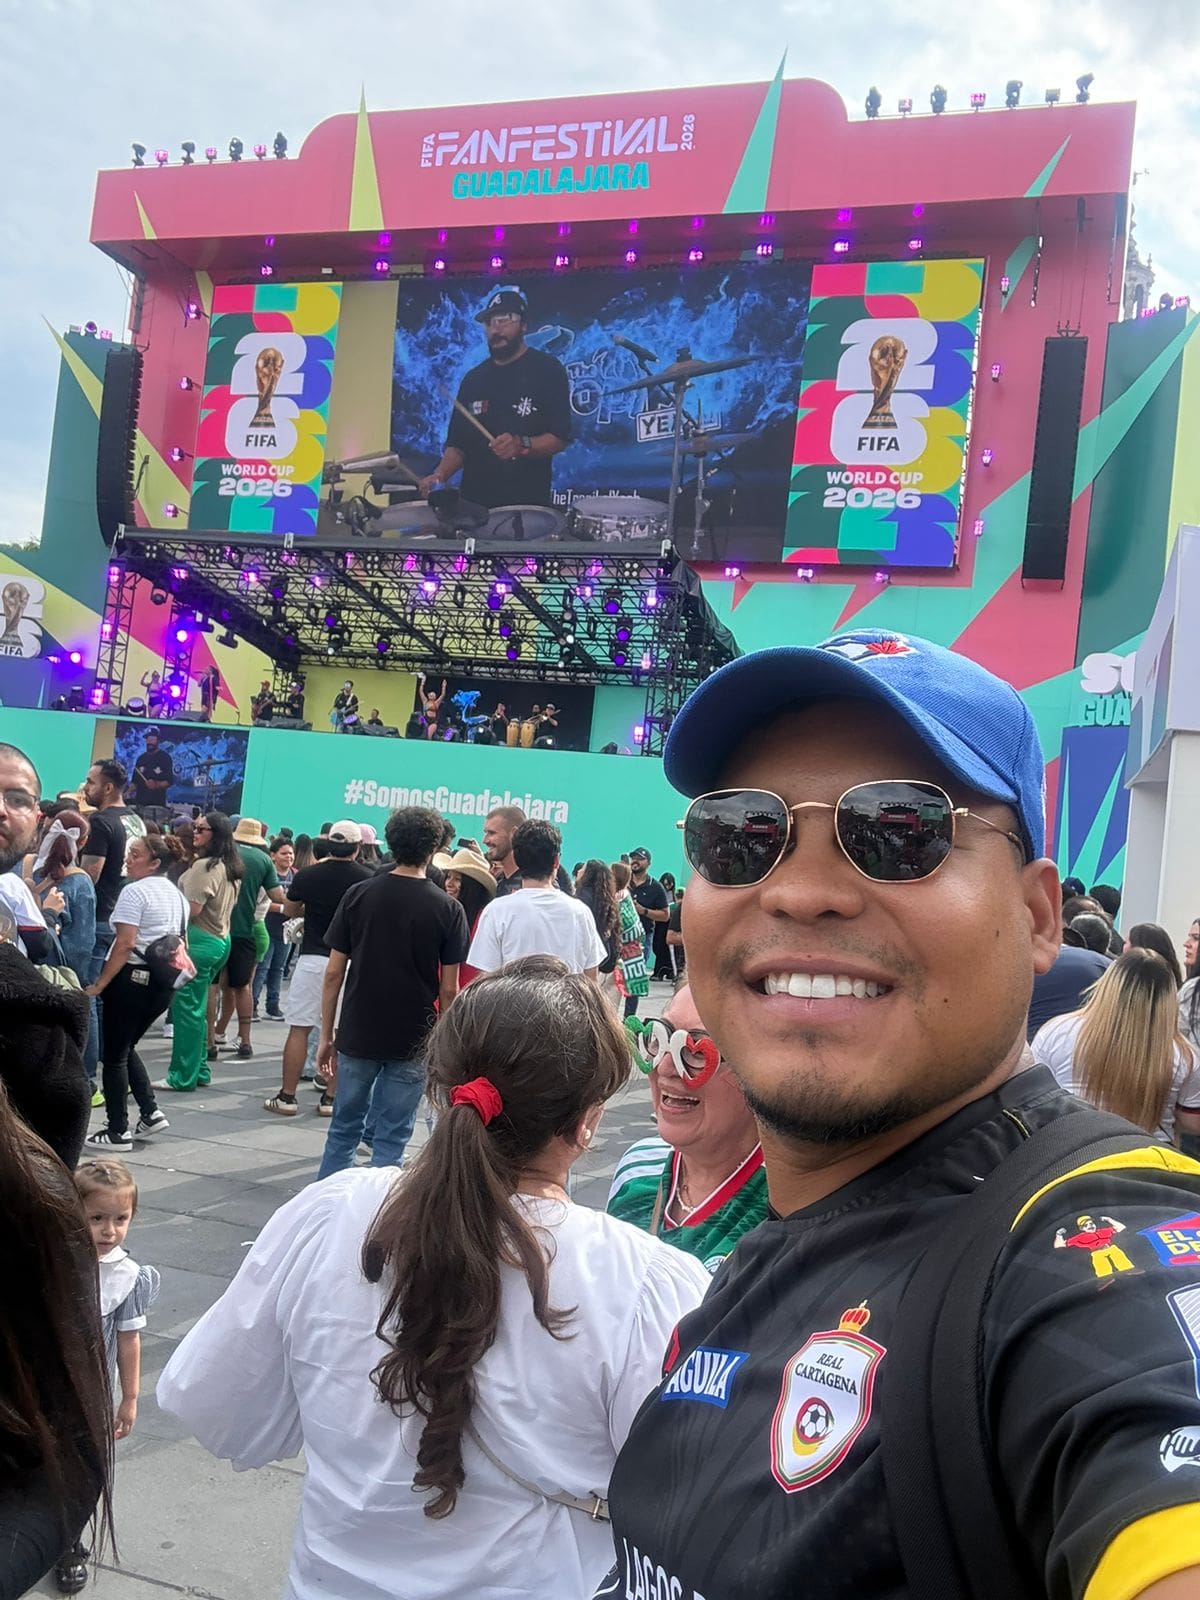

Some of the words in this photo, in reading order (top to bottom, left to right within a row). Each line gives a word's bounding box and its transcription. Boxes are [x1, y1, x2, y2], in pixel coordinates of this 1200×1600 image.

[680, 114, 696, 150] 2026
[420, 133, 436, 167] FIFA
[452, 162, 649, 199] GUADALAJARA
[245, 434, 277, 447] FIFA
[857, 436, 900, 451] FIFA
[221, 464, 267, 475] WORLD
[268, 465, 295, 476] CUP
[826, 471, 887, 485] WORLD
[889, 471, 923, 485] CUP
[218, 477, 293, 497] 2026
[823, 487, 922, 509] 2026
[1080, 699, 1130, 726] GUA
[1157, 1230, 1193, 1244] EL
[816, 1353, 844, 1370] REAL
[795, 1363, 858, 1395] CARTAGENA
